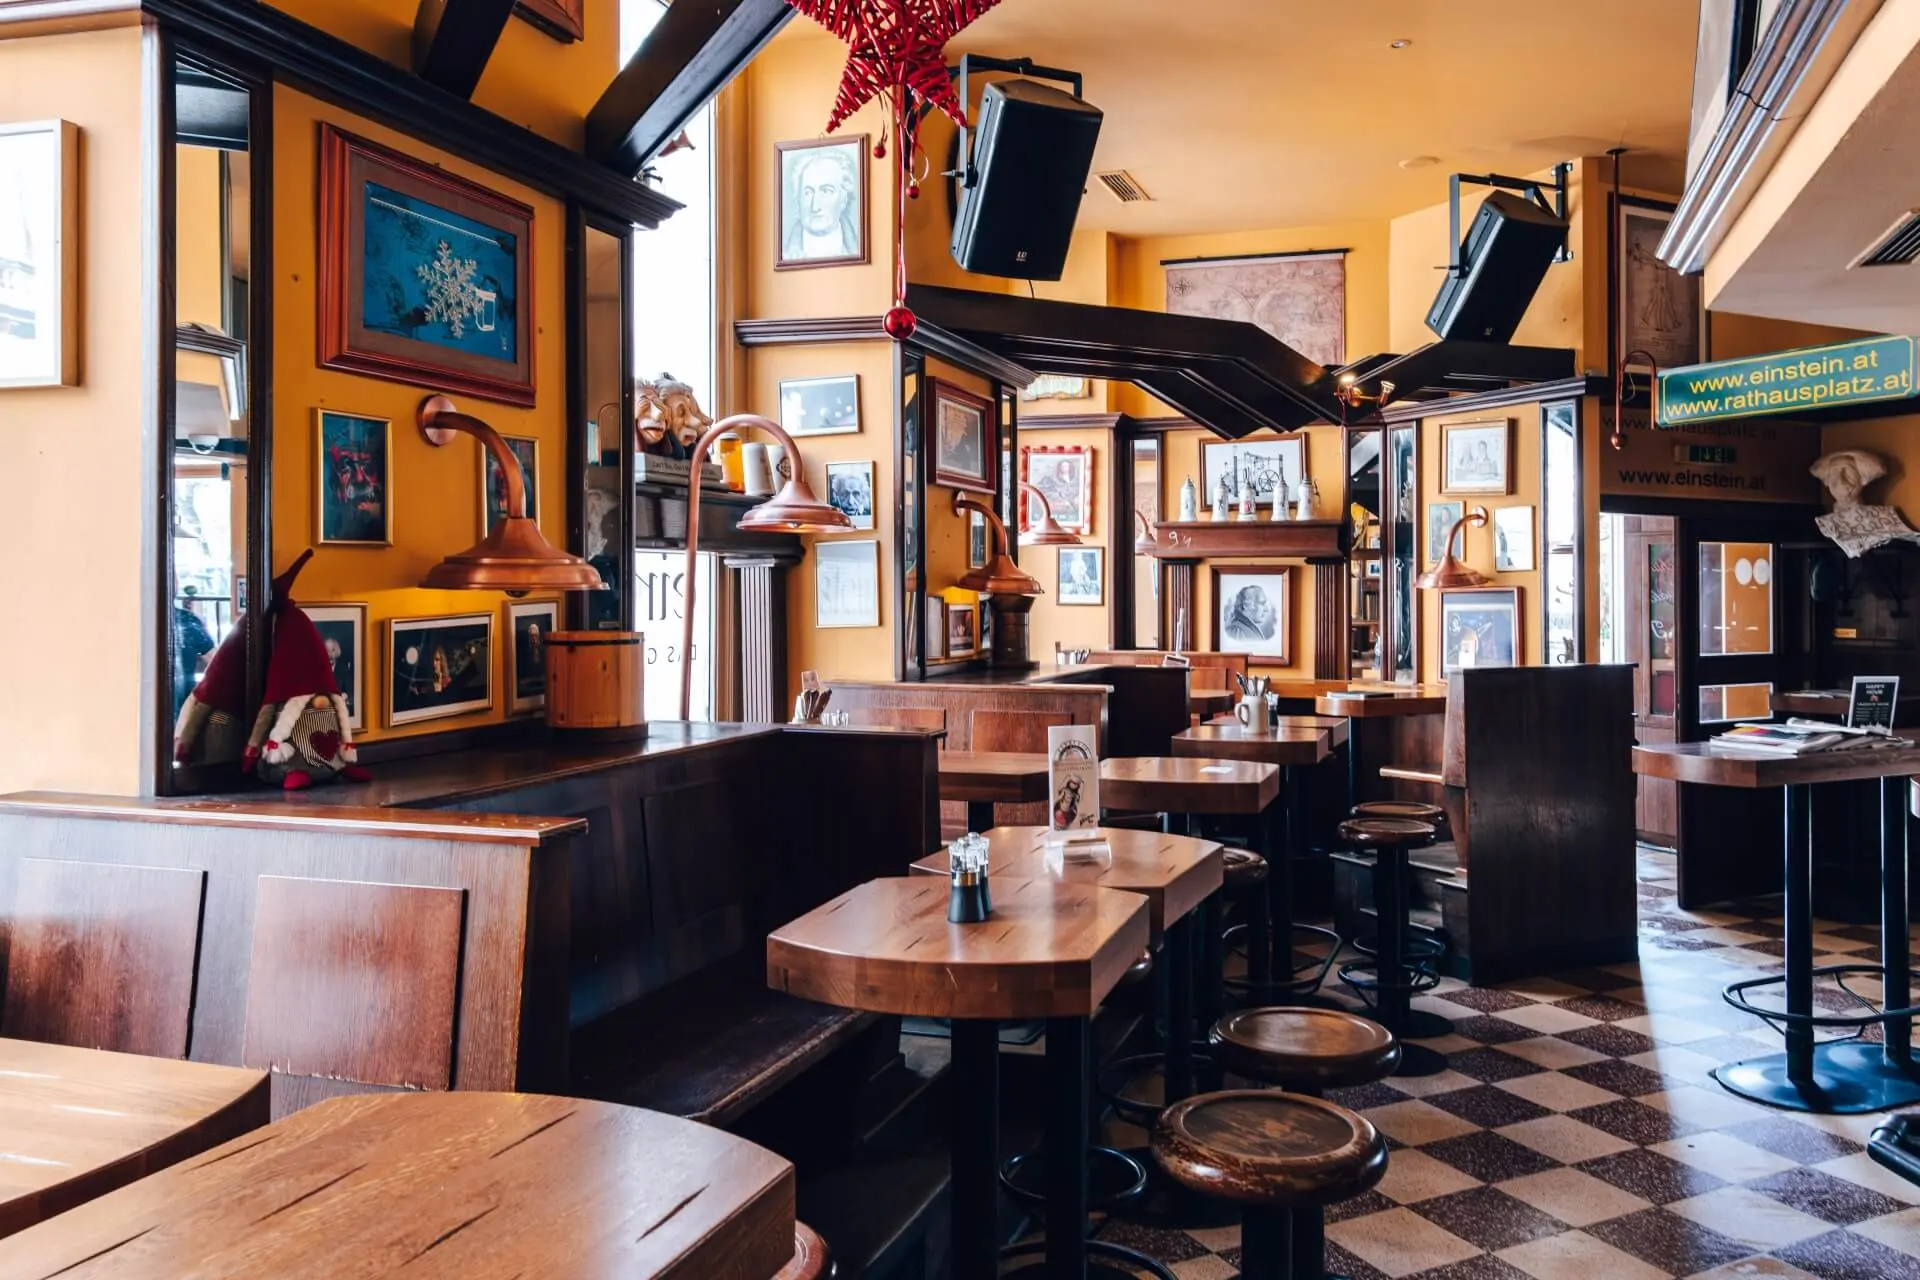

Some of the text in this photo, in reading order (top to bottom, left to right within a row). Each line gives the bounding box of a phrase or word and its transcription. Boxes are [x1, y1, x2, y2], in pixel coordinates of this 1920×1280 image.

[1689, 350, 1878, 394] www.einstein.at
[1666, 369, 1909, 417] www.rathausplatz.at
[1602, 414, 1777, 441] www.hausplatz.at
[1619, 468, 1767, 491] www.einstein.at
